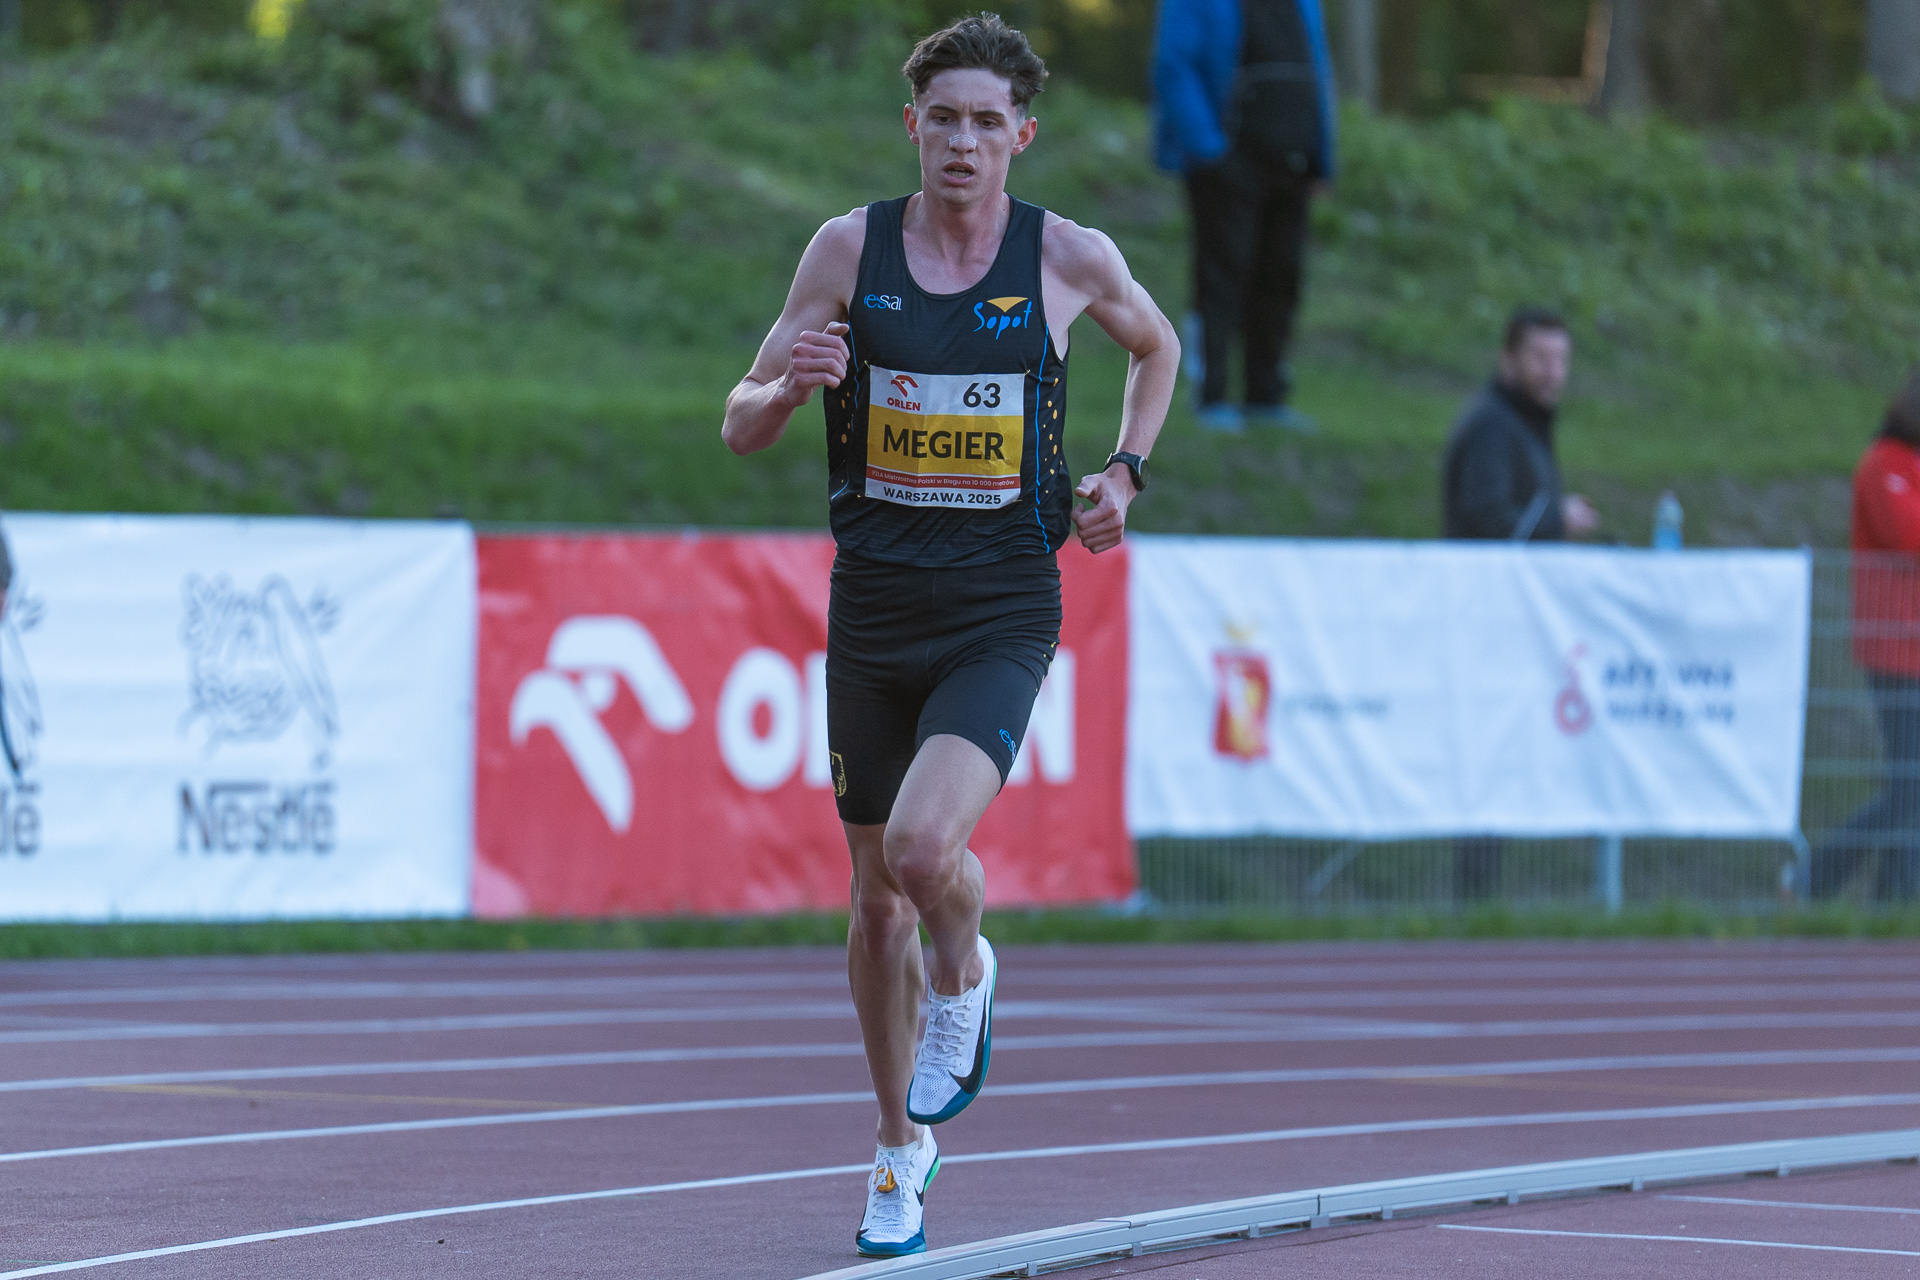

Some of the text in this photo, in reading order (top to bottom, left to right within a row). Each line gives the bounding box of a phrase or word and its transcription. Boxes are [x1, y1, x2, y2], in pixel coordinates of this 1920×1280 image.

[973, 300, 1033, 340] Sopot
[887, 396, 921, 412] ORLEN
[962, 382, 1001, 409] 63
[883, 423, 1005, 461] MEGIER
[871, 470, 884, 478] PZLA
[884, 473, 917, 484] Mistrzostwa
[992, 479, 1015, 487] metrów
[883, 486, 1002, 505] WARSZAWA 2025
